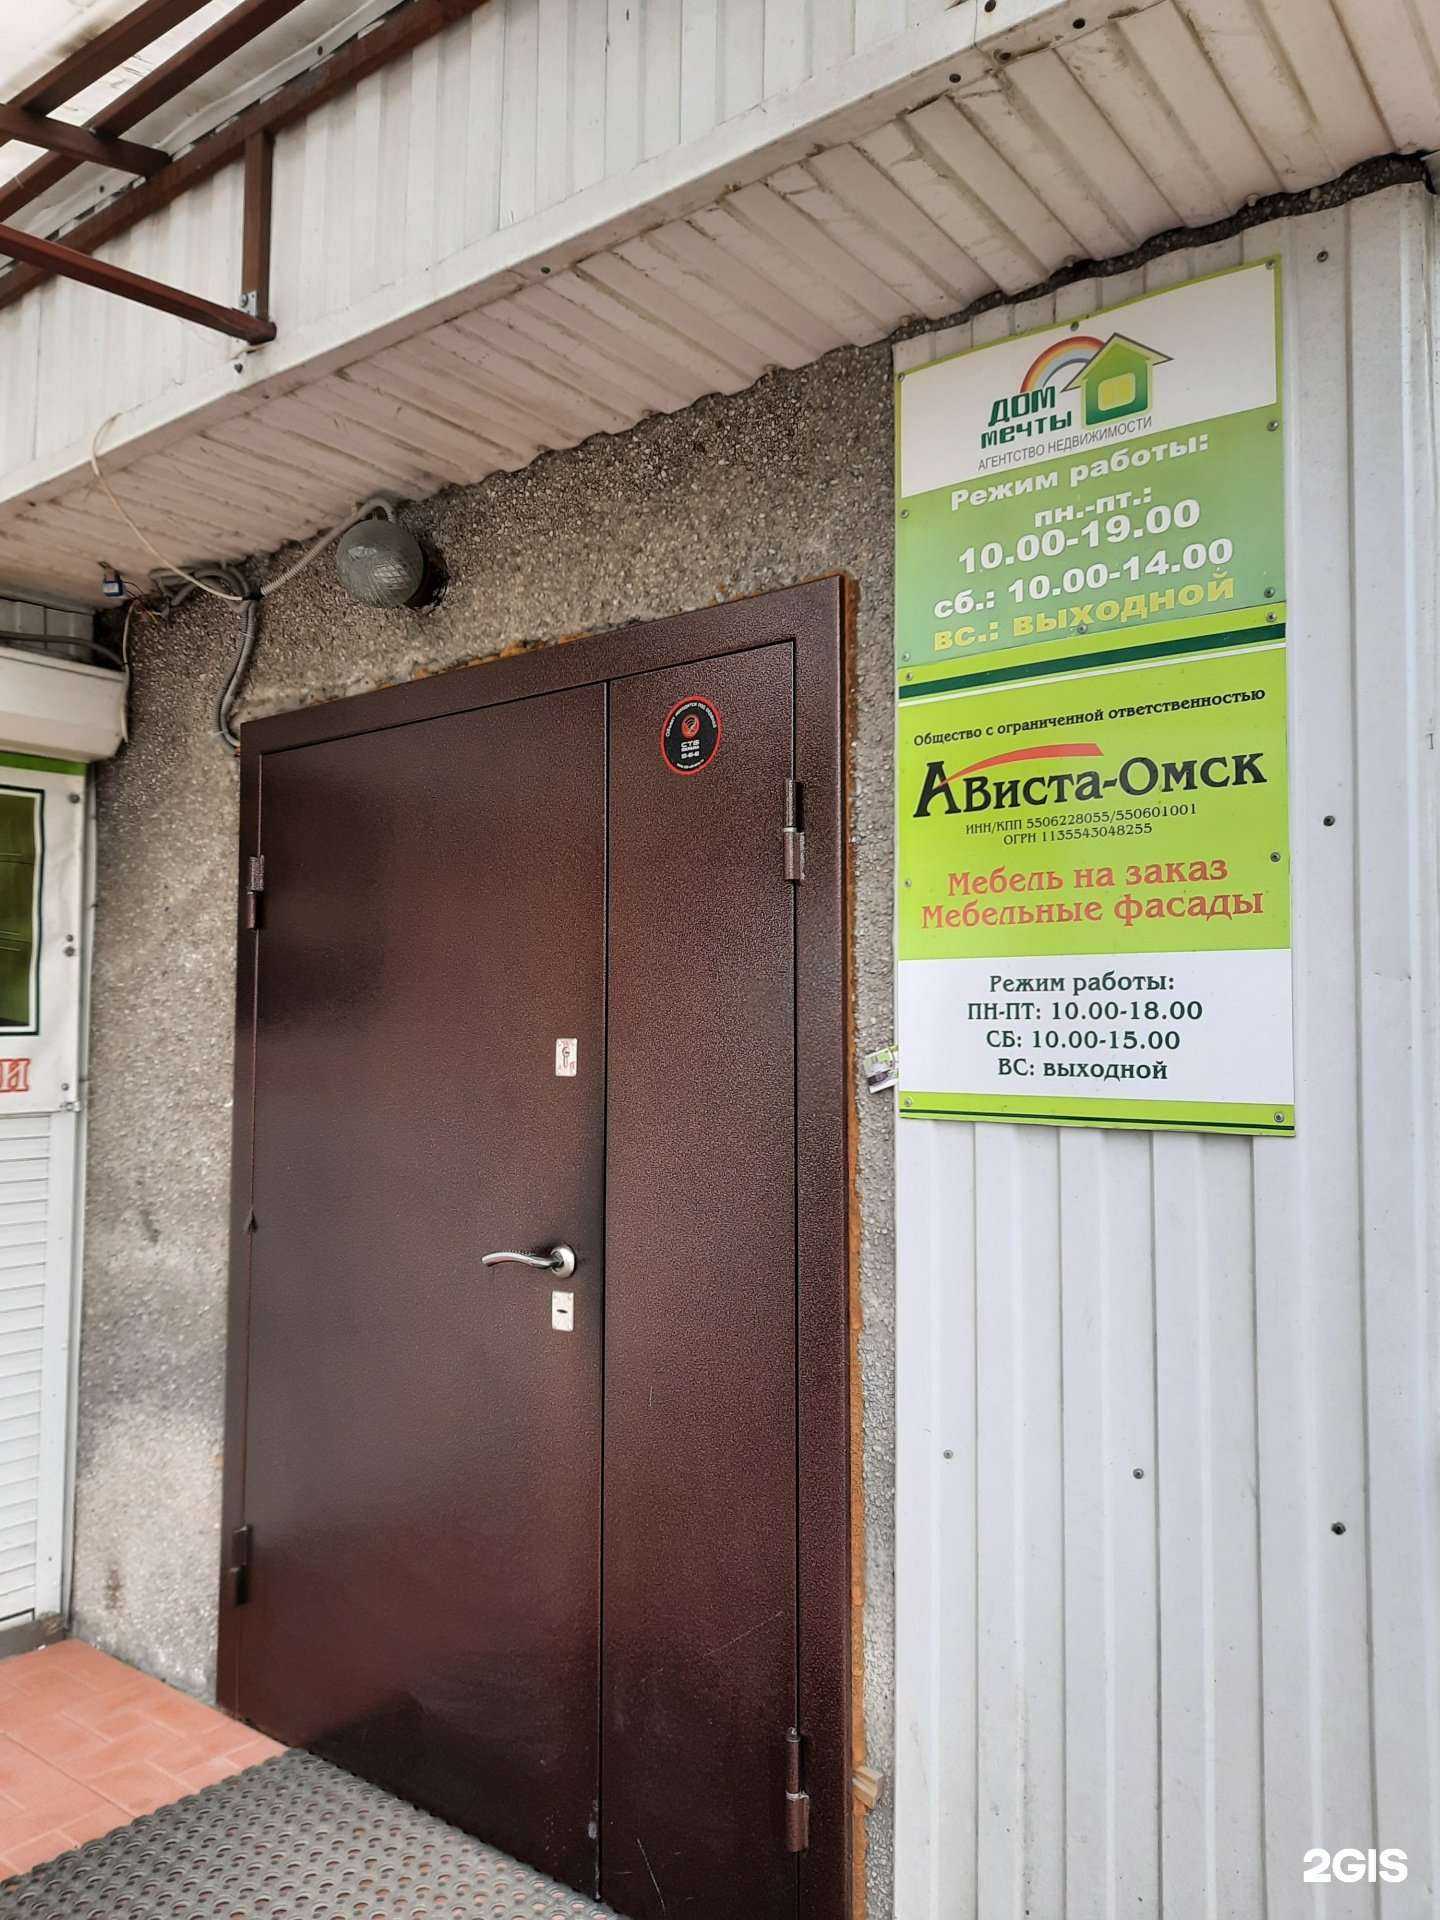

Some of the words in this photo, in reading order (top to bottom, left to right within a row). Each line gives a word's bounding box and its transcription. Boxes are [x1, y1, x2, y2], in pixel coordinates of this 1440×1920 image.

[988, 385, 1057, 427] ДОМ
[977, 443, 1046, 472] АГЕНТСТВО
[1048, 415, 1153, 454] НЕДВИЖИМОСТИ
[950, 470, 1059, 511] Режим
[1070, 434, 1209, 488] работы:
[1034, 485, 1153, 528] пн.-пт.:
[958, 499, 1201, 575] 10.00-19.00
[933, 588, 996, 619] сб.:
[1008, 537, 1234, 604] 10.00-14.00
[913, 728, 982, 747] Общество
[986, 726, 994, 737] с
[996, 708, 1105, 736] ограниченной
[1108, 688, 1266, 720] ответственностью
[965, 819, 1022, 836] ИНН/КПП
[1026, 803, 1197, 829] 5506228055/550601001
[1003, 832, 1036, 846] ОГРН
[1041, 822, 1153, 844] 1135543048255
[947, 863, 1064, 896] Мебель
[1073, 863, 1115, 889] на
[1125, 858, 1229, 885] заказ
[921, 896, 1104, 929] Мебельные
[1113, 892, 1265, 927] фасады
[989, 975, 1066, 992] Режим
[1072, 972, 1175, 996] работы:
[967, 1002, 1042, 1021] ПН-ПТ:
[1050, 1000, 1204, 1021] 10.00-18.00
[985, 1030, 1023, 1049] СБ:
[1031, 1030, 1181, 1051] 10.00-15.00
[997, 1058, 1036, 1077] ВС:
[1042, 1058, 1169, 1083] выходной
